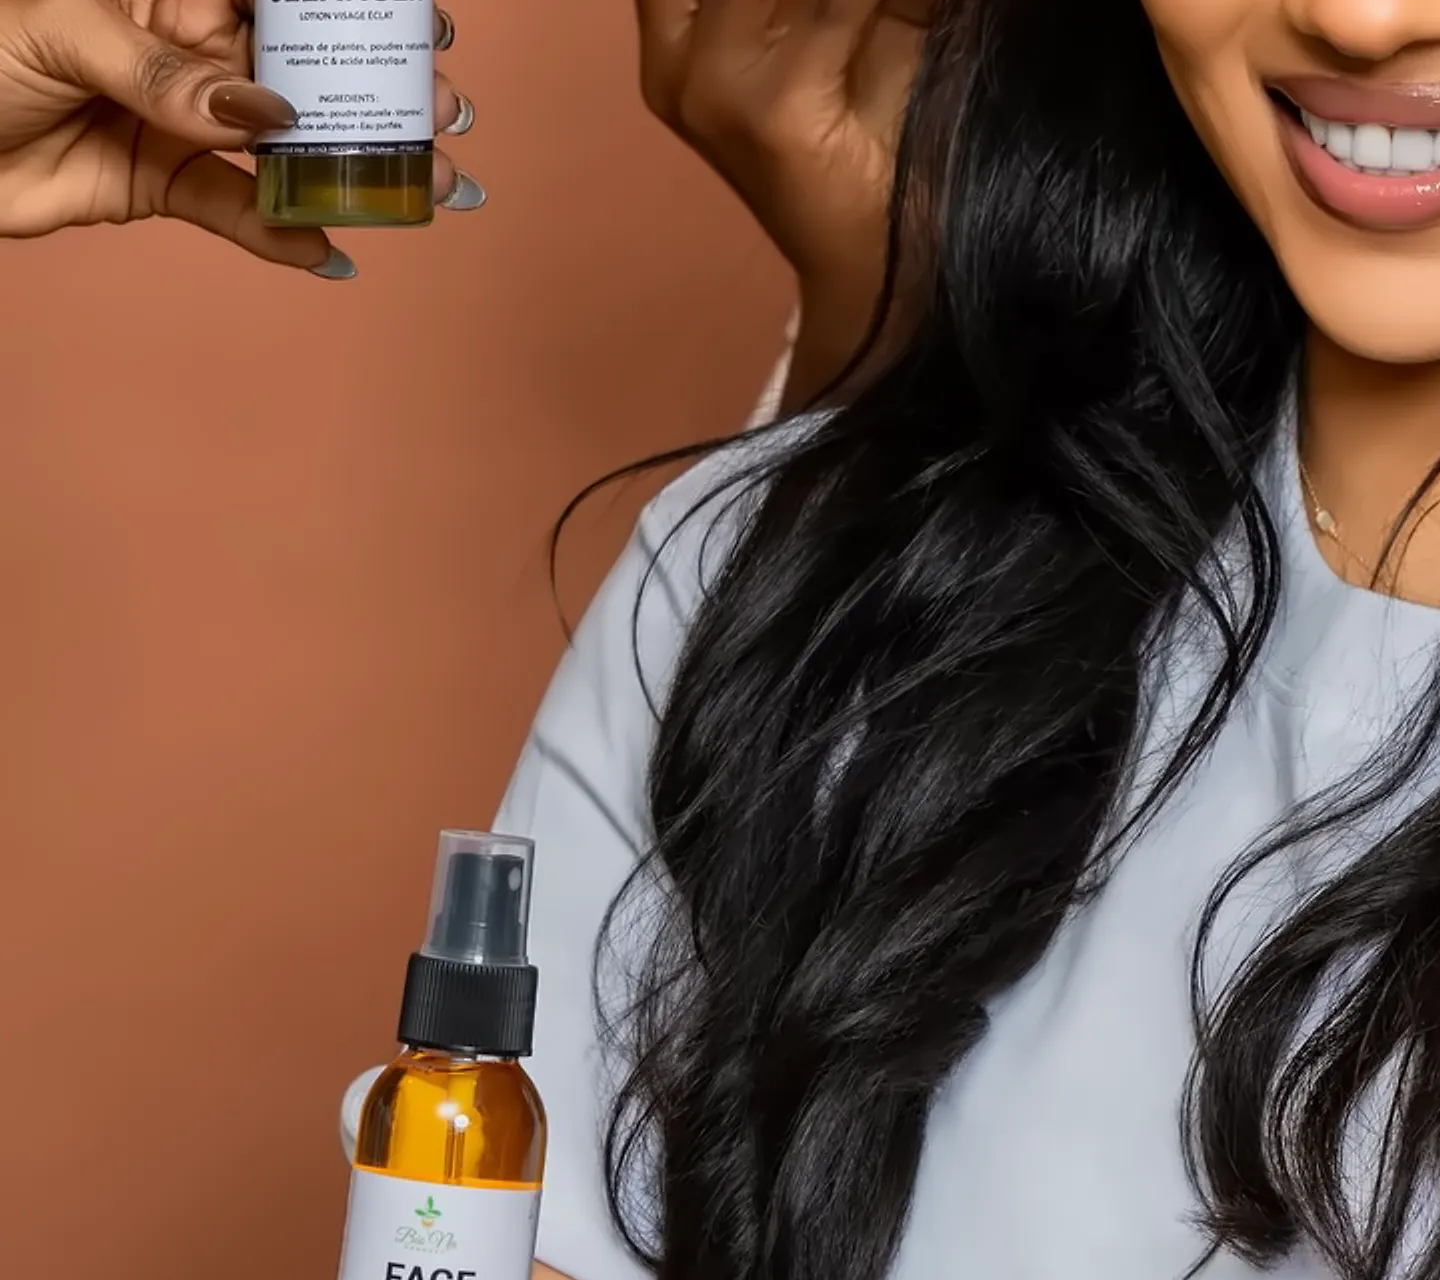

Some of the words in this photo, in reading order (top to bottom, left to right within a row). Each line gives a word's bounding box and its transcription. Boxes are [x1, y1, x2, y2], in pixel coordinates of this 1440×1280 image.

[299, 11, 331, 21] LOTION
[332, 11, 366, 20] VISAGE
[316, 41, 329, 51] de
[286, 56, 321, 66] vitamine
[322, 56, 329, 65] C
[330, 56, 337, 65] &
[340, 56, 364, 65] acide
[360, 121, 374, 130] Eau
